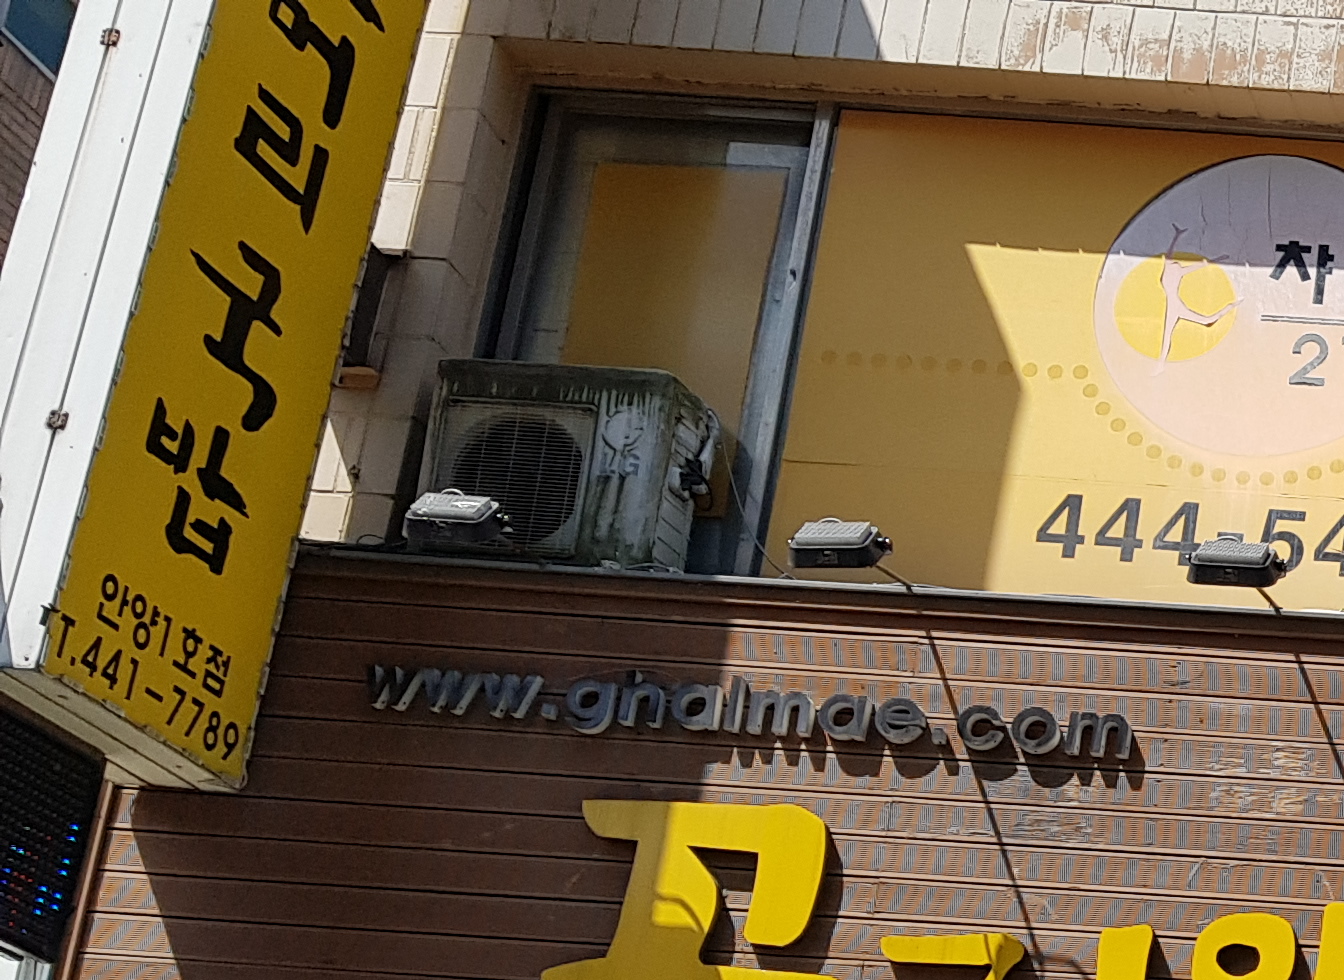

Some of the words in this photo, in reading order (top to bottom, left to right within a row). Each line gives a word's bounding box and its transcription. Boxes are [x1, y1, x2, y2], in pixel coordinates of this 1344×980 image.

[145, 0, 385, 576] 머리국밥
[55, 612, 239, 761] T.441-7789
[101, 574, 232, 698] 안양1호점
[366, 663, 1134, 761] www.ghalmae.com
